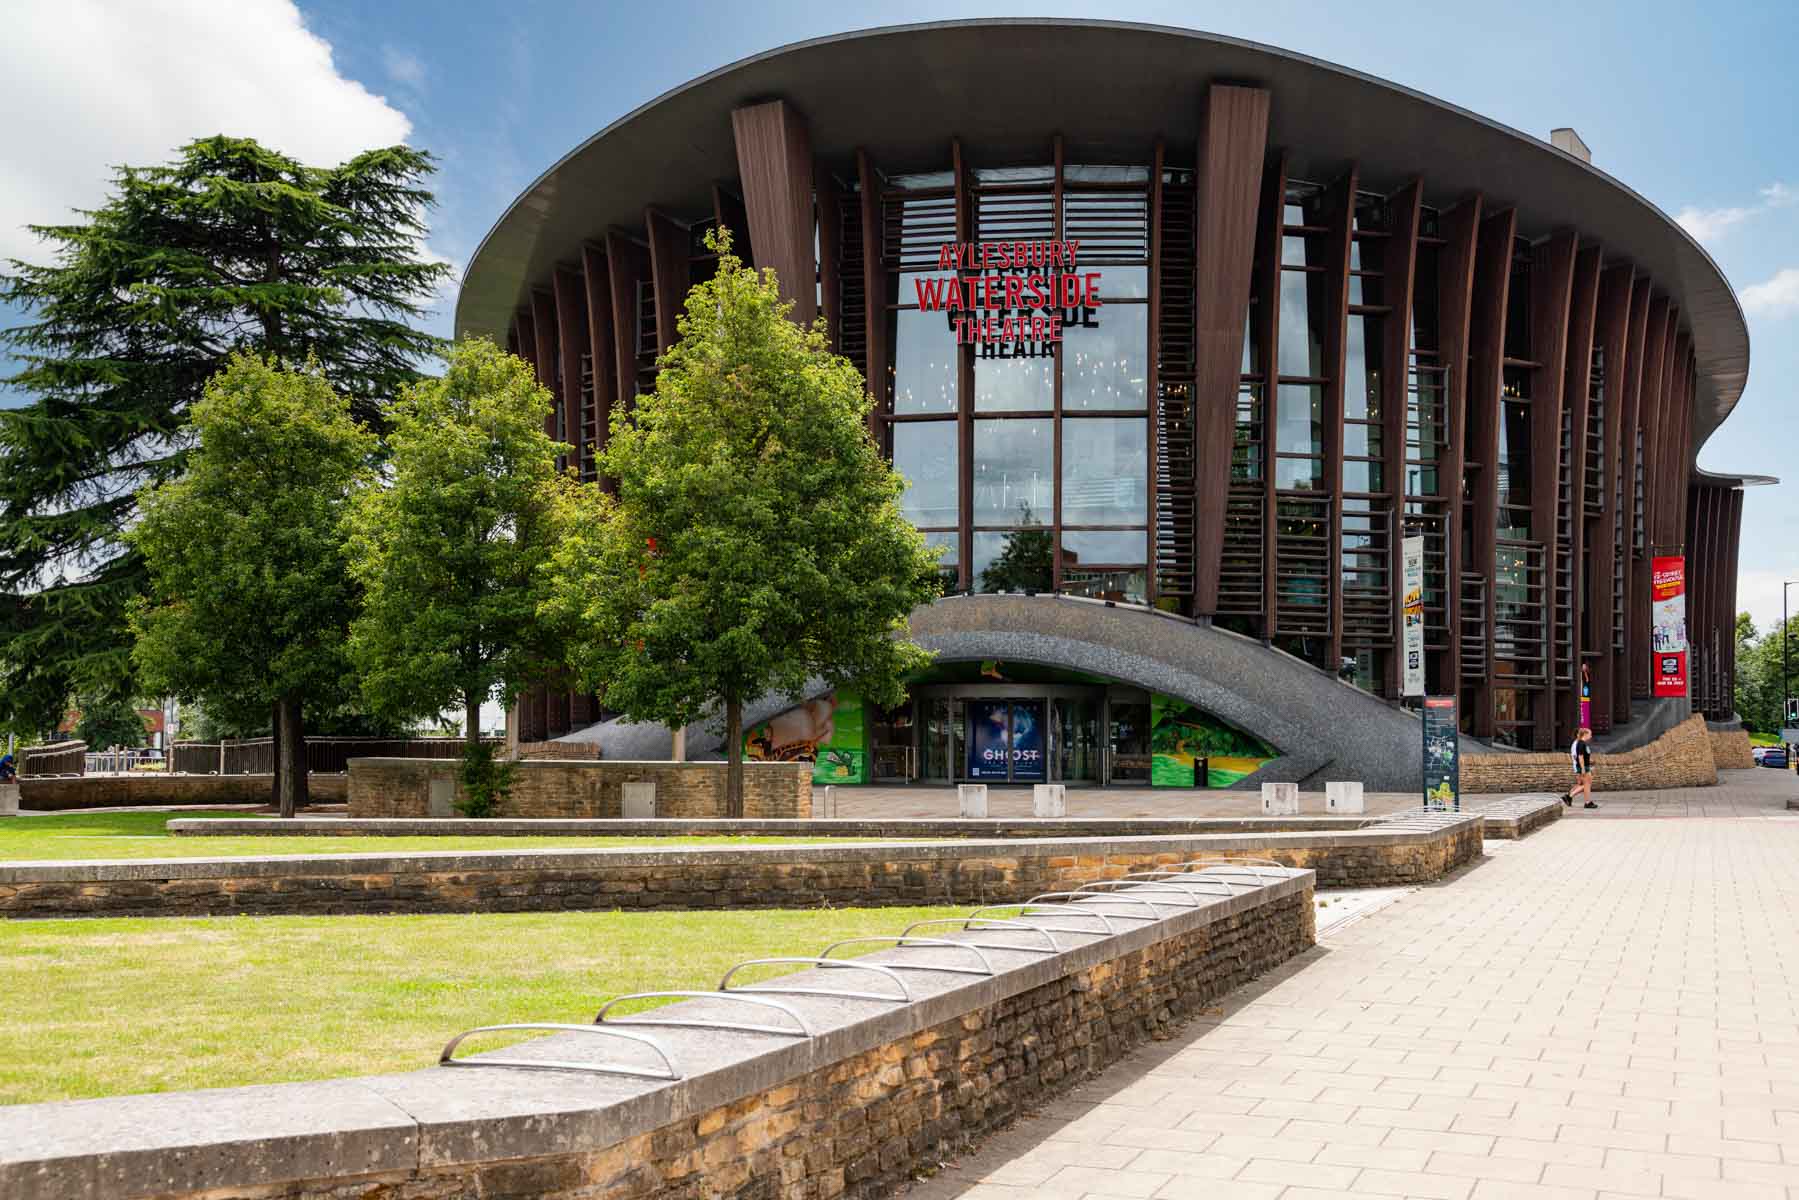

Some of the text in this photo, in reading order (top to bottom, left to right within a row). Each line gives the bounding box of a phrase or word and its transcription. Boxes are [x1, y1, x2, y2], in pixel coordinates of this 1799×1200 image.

[938, 240, 1080, 270] AYLESBURY
[914, 272, 1103, 313] WATERSIDE
[952, 315, 1064, 345] THEATRE
[983, 749, 1039, 761] GHOST
